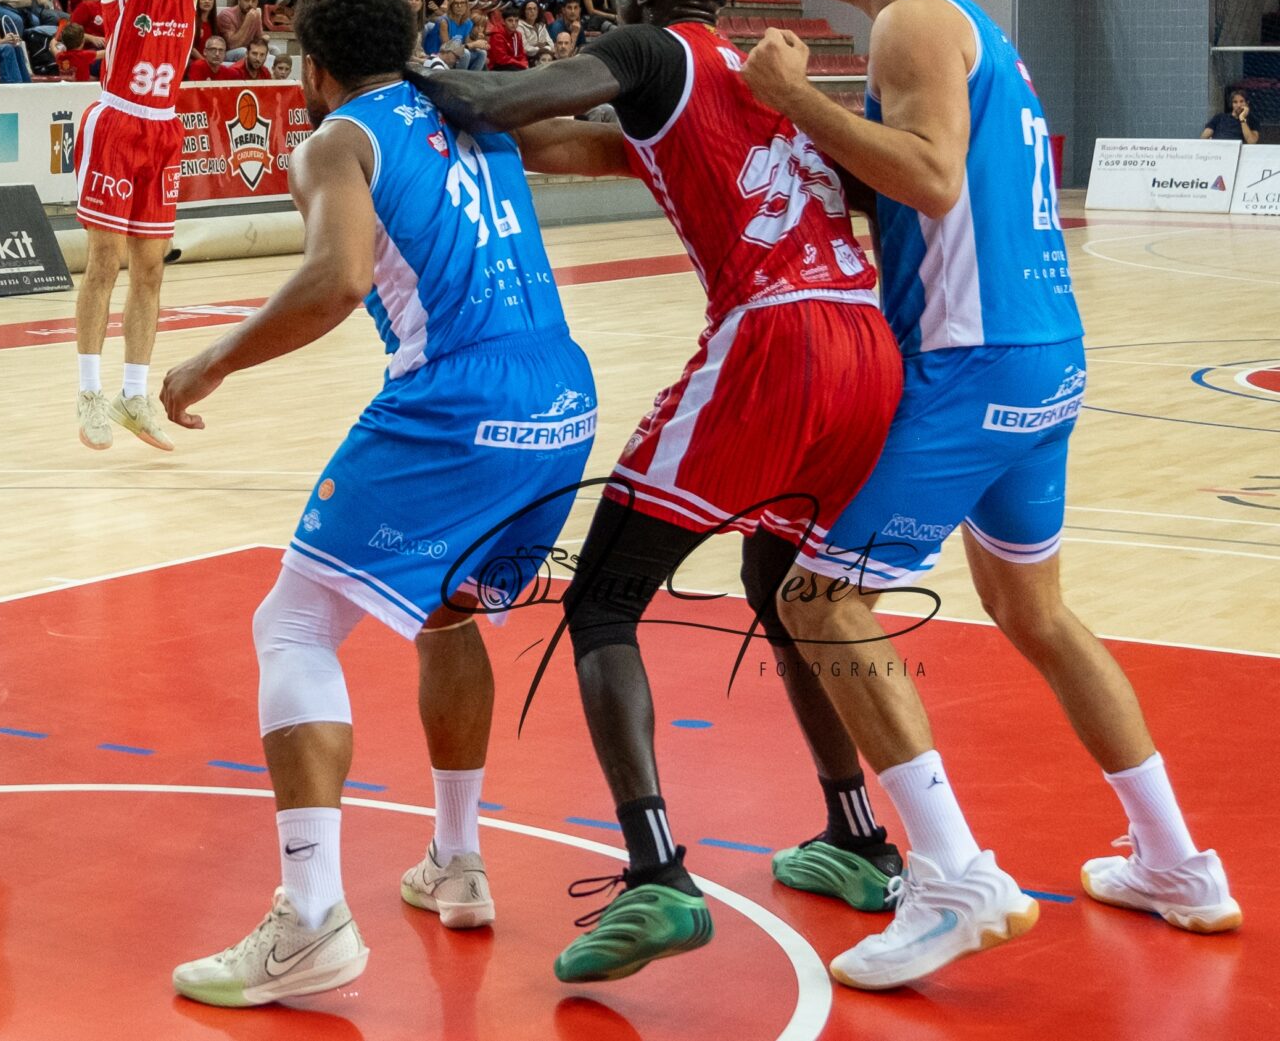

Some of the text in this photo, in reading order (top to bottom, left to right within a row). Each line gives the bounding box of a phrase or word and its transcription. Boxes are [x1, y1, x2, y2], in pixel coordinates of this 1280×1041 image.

[129, 61, 175, 97] 32
[180, 112, 209, 130] MPRE
[182, 136, 197, 153] MB
[234, 133, 265, 148] FRENTE
[180, 154, 226, 176] ENICARLÓ
[1151, 177, 1209, 189] helvetia
[1242, 192, 1259, 203] LA
[482, 413, 597, 445] IBIZAKARTI
[368, 529, 448, 560] MAMBO
